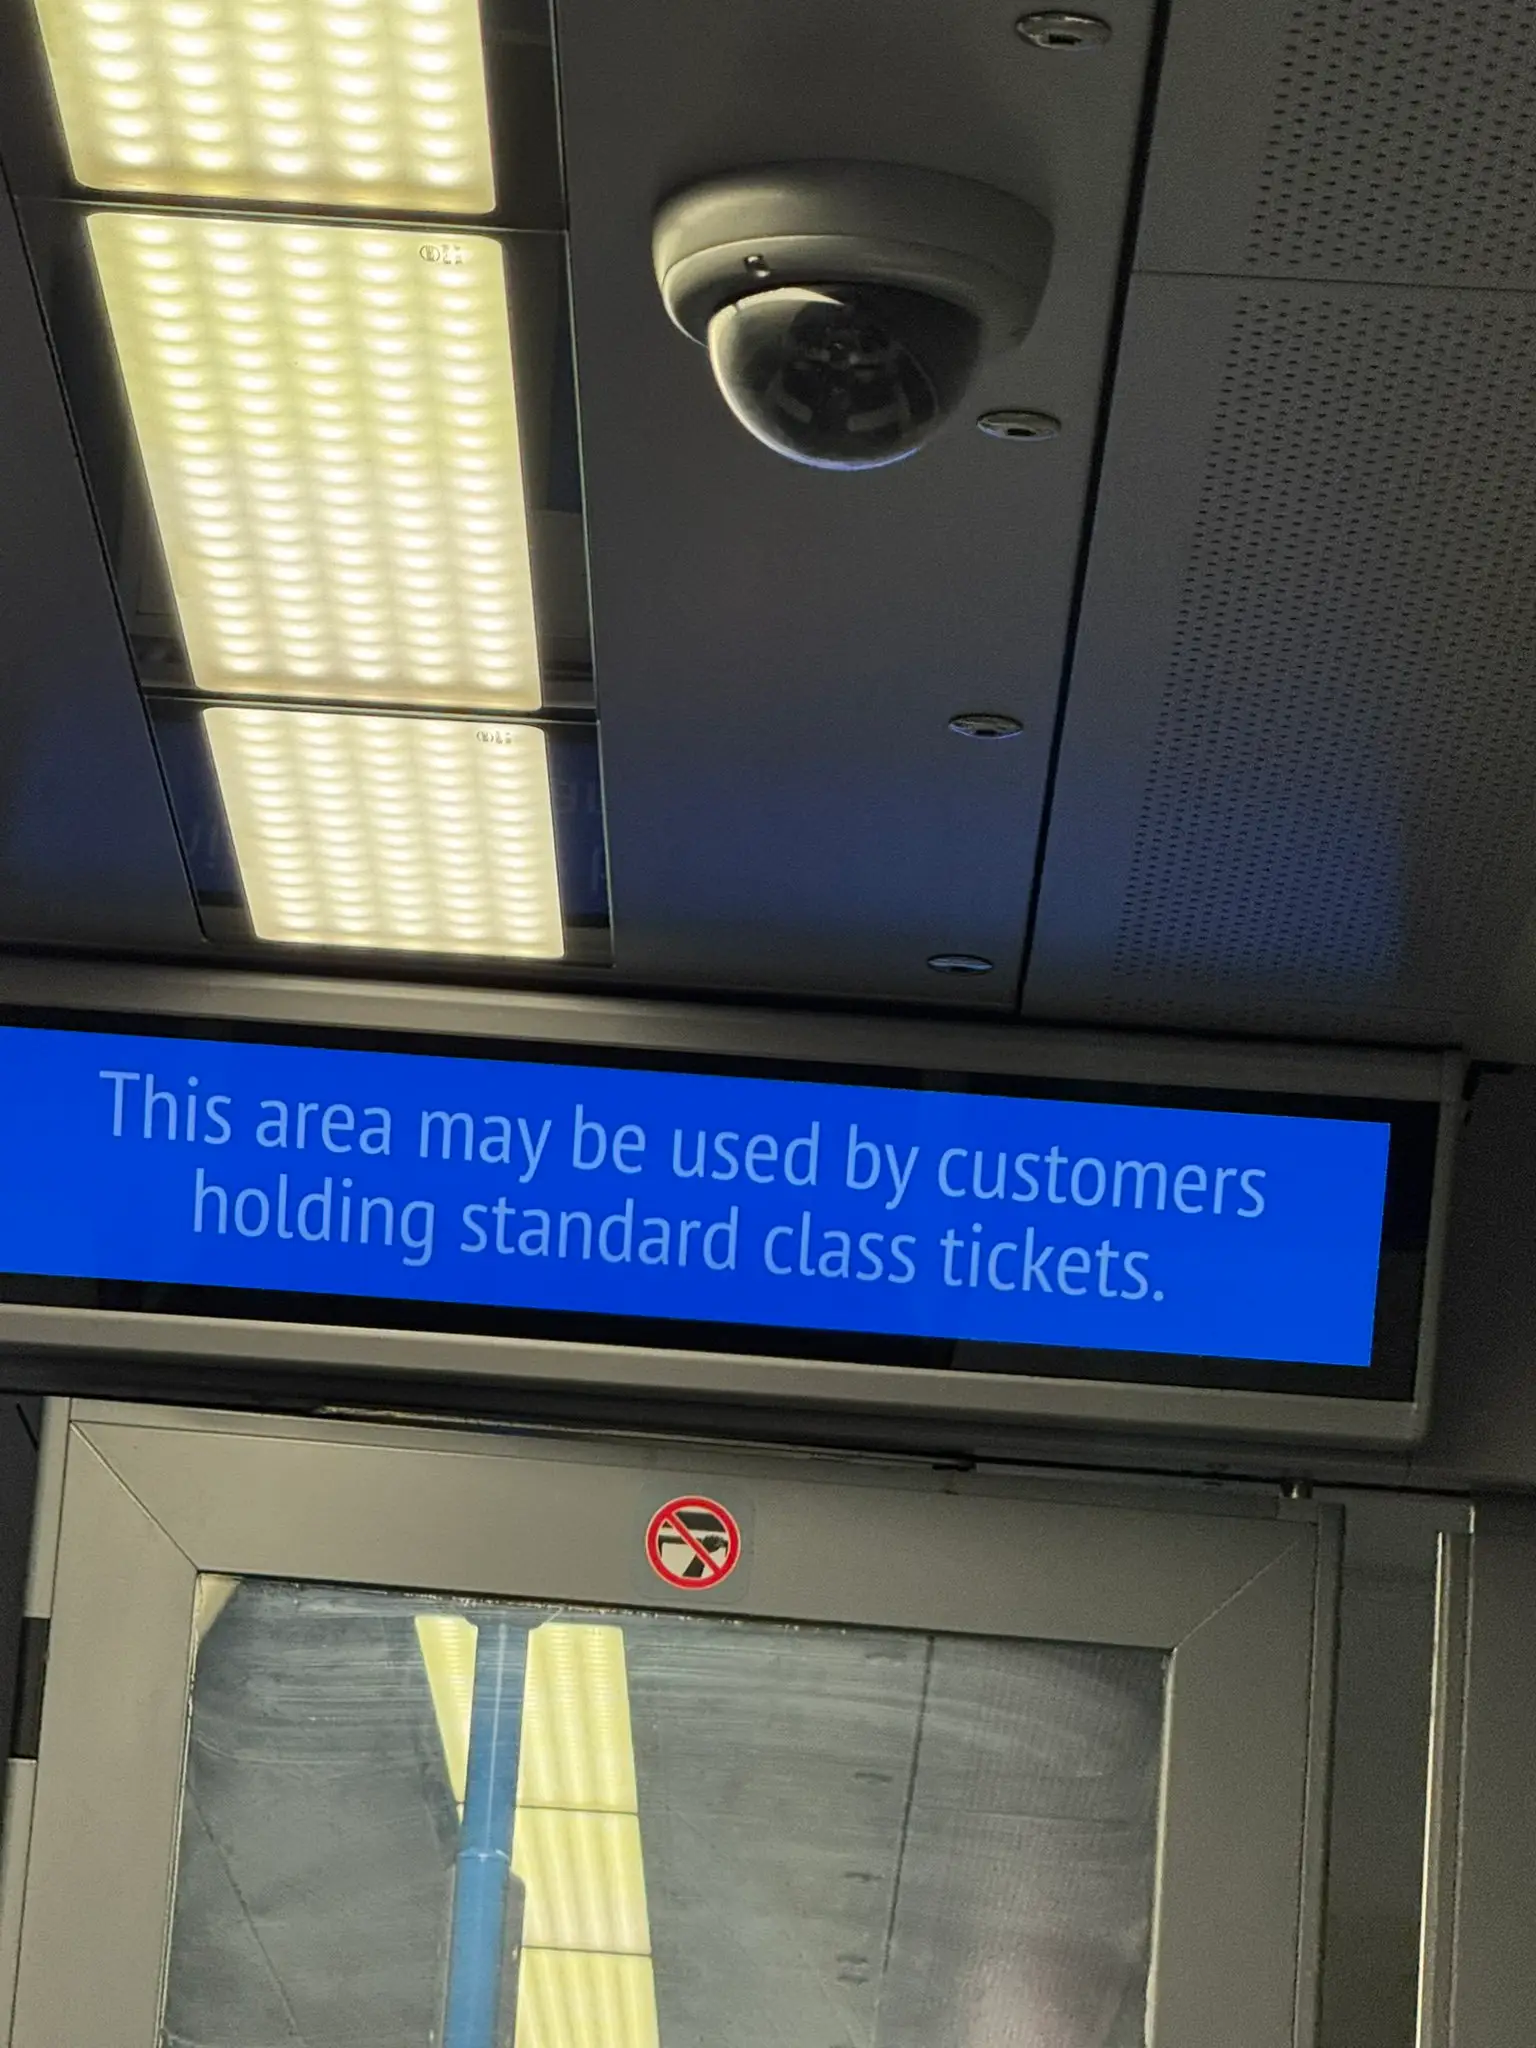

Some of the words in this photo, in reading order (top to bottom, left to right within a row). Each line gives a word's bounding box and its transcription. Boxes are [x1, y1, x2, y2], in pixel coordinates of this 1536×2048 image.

[99, 1070, 232, 1145] This
[255, 1100, 392, 1156] area
[419, 1111, 552, 1184] may
[572, 1103, 646, 1174] be
[672, 1121, 820, 1191] used
[846, 1123, 920, 1210] by
[938, 1145, 1267, 1219] customers
[193, 1167, 435, 1266] holding
[460, 1196, 739, 1270] standard
[764, 1210, 917, 1285] class
[940, 1222, 1165, 1302] tickets.
